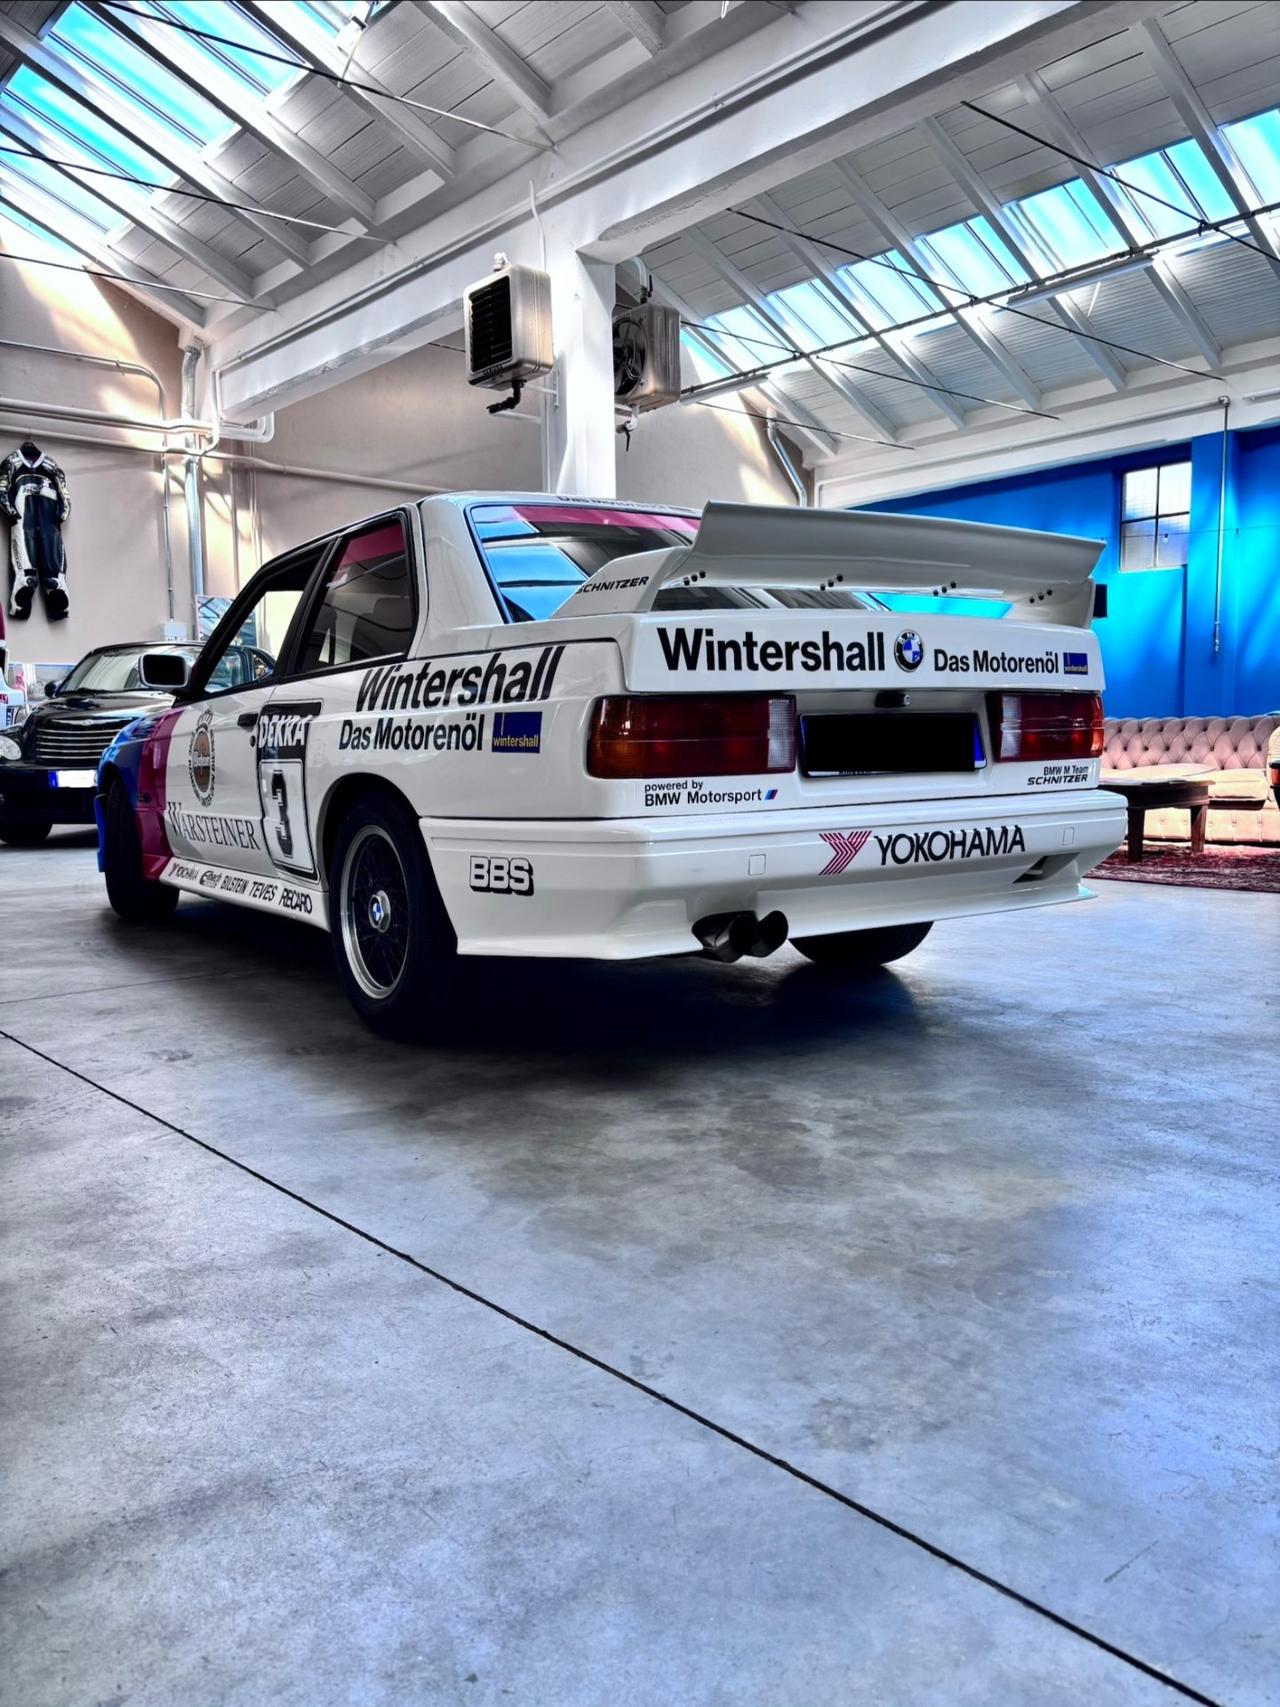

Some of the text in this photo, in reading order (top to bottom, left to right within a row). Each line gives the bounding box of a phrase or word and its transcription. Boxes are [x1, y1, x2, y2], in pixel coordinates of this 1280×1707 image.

[657, 627, 885, 672] Wintershall
[934, 649, 1059, 674] Das Motorenöl
[355, 646, 566, 713] Wintershall
[338, 712, 485, 751] Das Motorenöl
[493, 734, 540, 748] wintershall
[644, 780, 703, 793] powered by
[1026, 774, 1089, 785] SCHNITZER
[1043, 764, 1089, 776] BMW M Team
[270, 769, 293, 859] 3
[644, 788, 762, 807] BMW Motorsport
[874, 824, 1026, 866] YOKOHAMA
[469, 855, 535, 896] BBS
[249, 881, 278, 902] TEVES
[279, 887, 313, 915] RECARO
